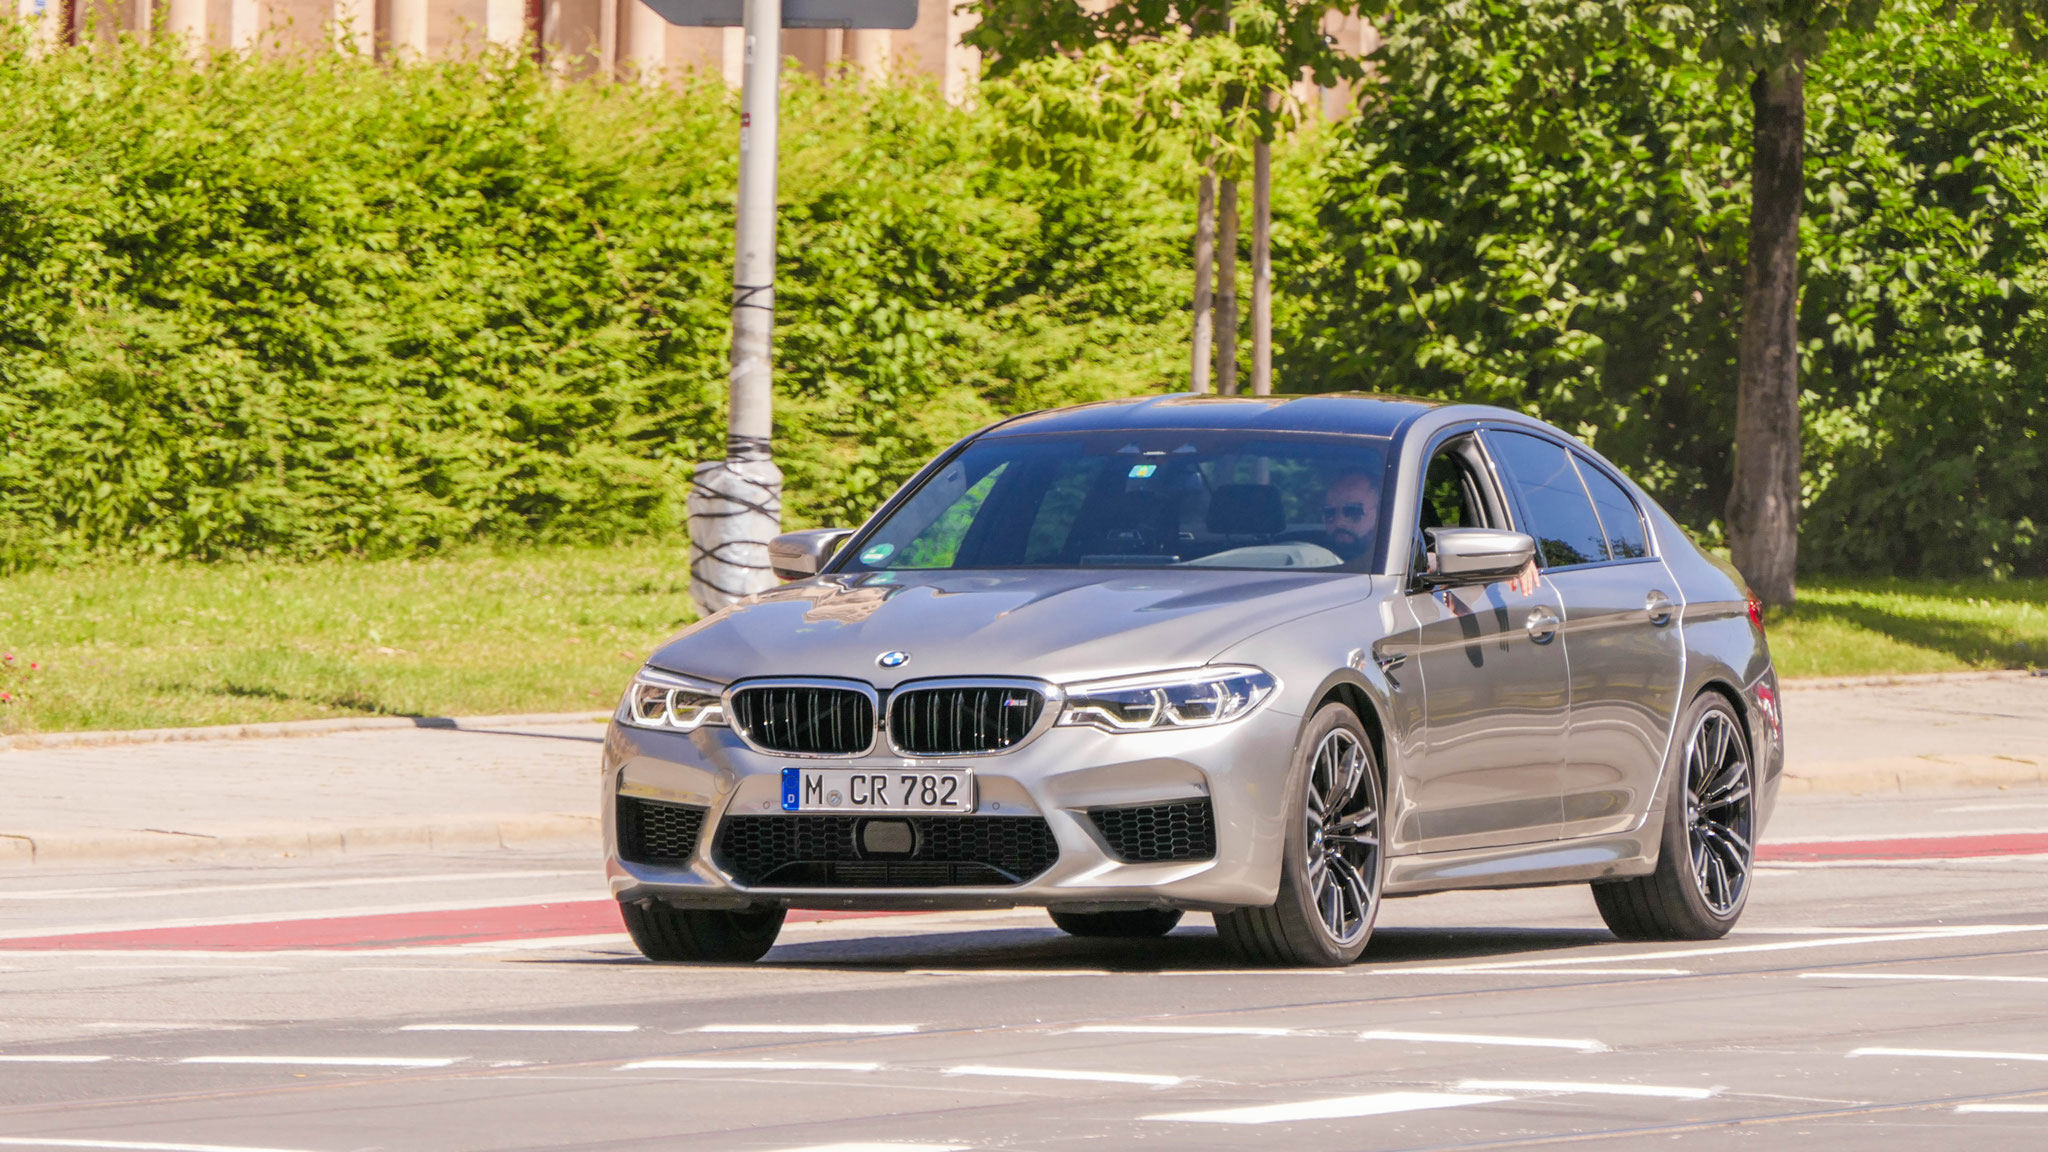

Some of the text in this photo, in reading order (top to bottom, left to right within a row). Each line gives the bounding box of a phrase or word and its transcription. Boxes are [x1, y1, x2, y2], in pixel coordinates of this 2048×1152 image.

[788, 794, 795, 803] D
[805, 774, 958, 806] M CR 782
